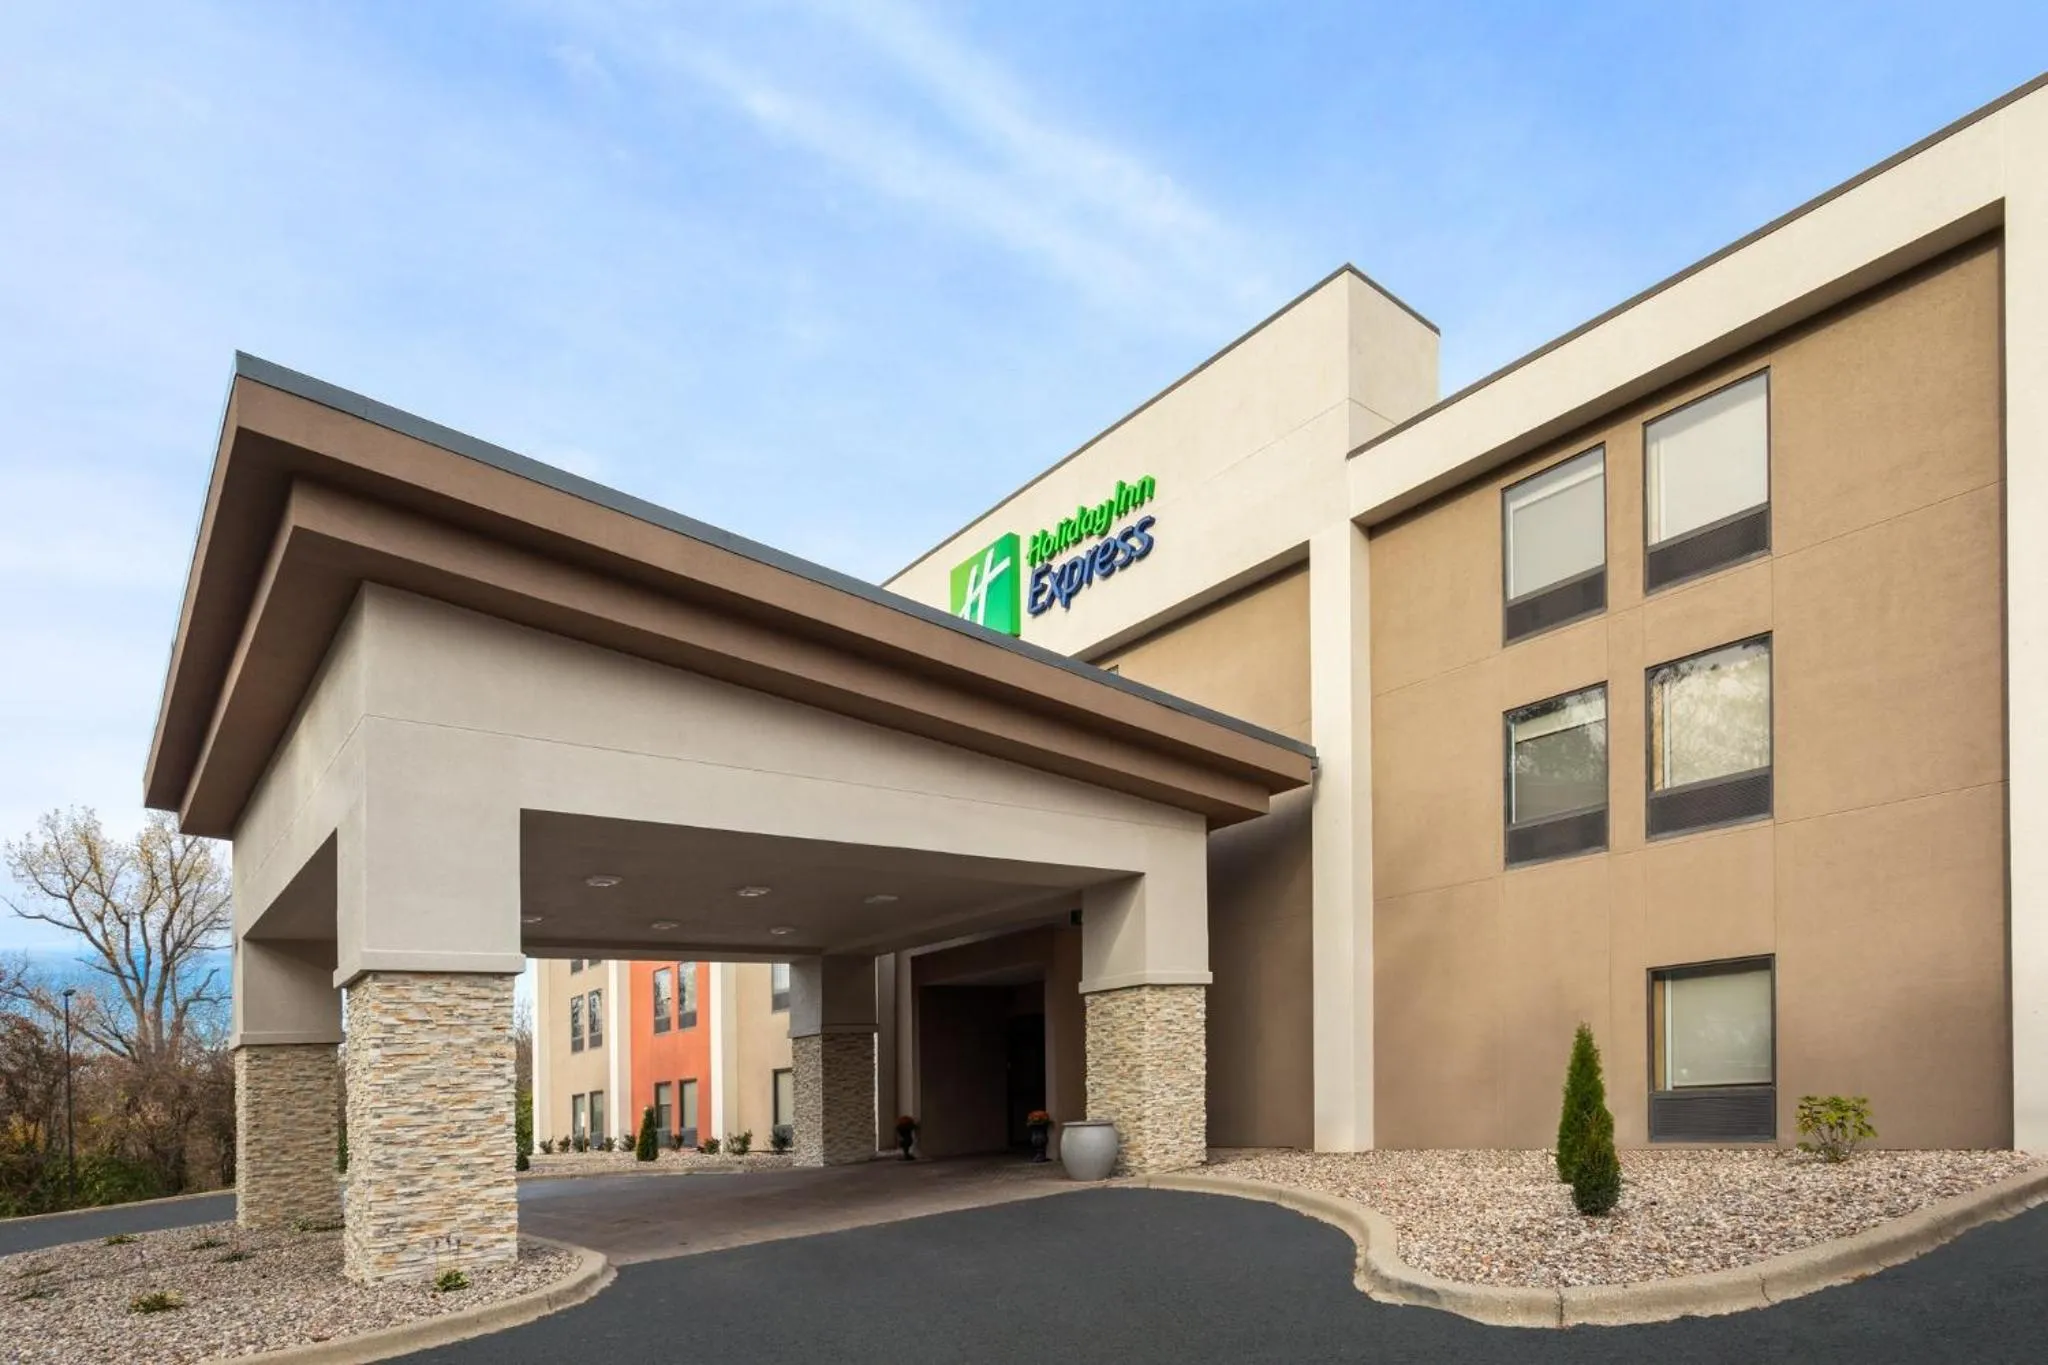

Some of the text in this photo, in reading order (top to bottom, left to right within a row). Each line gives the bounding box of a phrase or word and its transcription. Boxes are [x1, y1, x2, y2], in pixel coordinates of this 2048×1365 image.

[1027, 475, 1156, 567] Holiday Inn
[1027, 515, 1156, 616] Express
